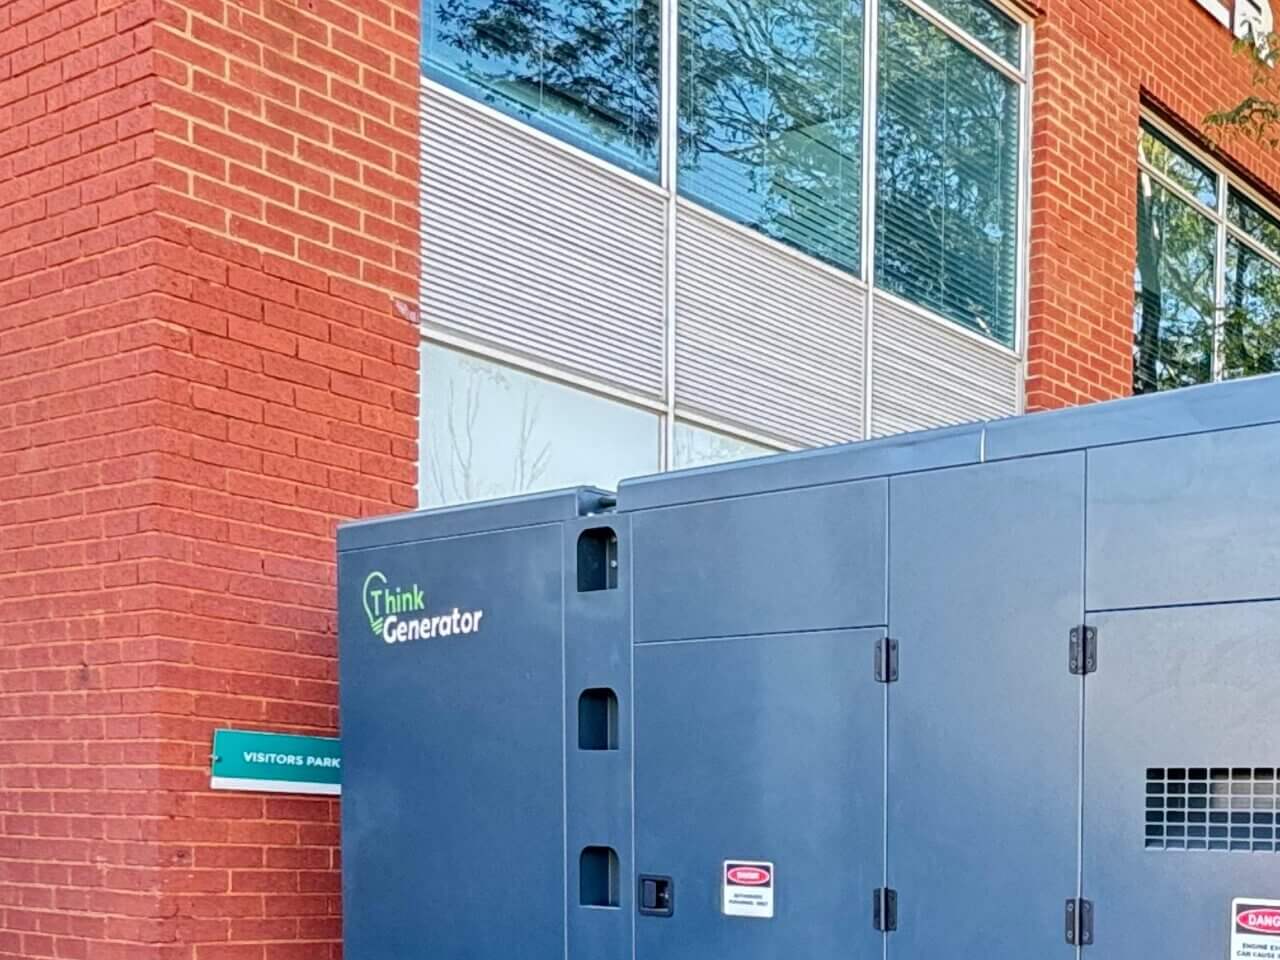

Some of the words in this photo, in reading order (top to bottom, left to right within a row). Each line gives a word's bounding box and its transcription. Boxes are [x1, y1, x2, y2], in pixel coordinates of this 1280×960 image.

[370, 583, 425, 616] Think
[383, 607, 483, 644] Generator
[243, 751, 304, 766] VISITORS
[306, 756, 341, 769] PARK
[1242, 942, 1268, 951] ENGINE
[1253, 951, 1275, 959] CAUSE
